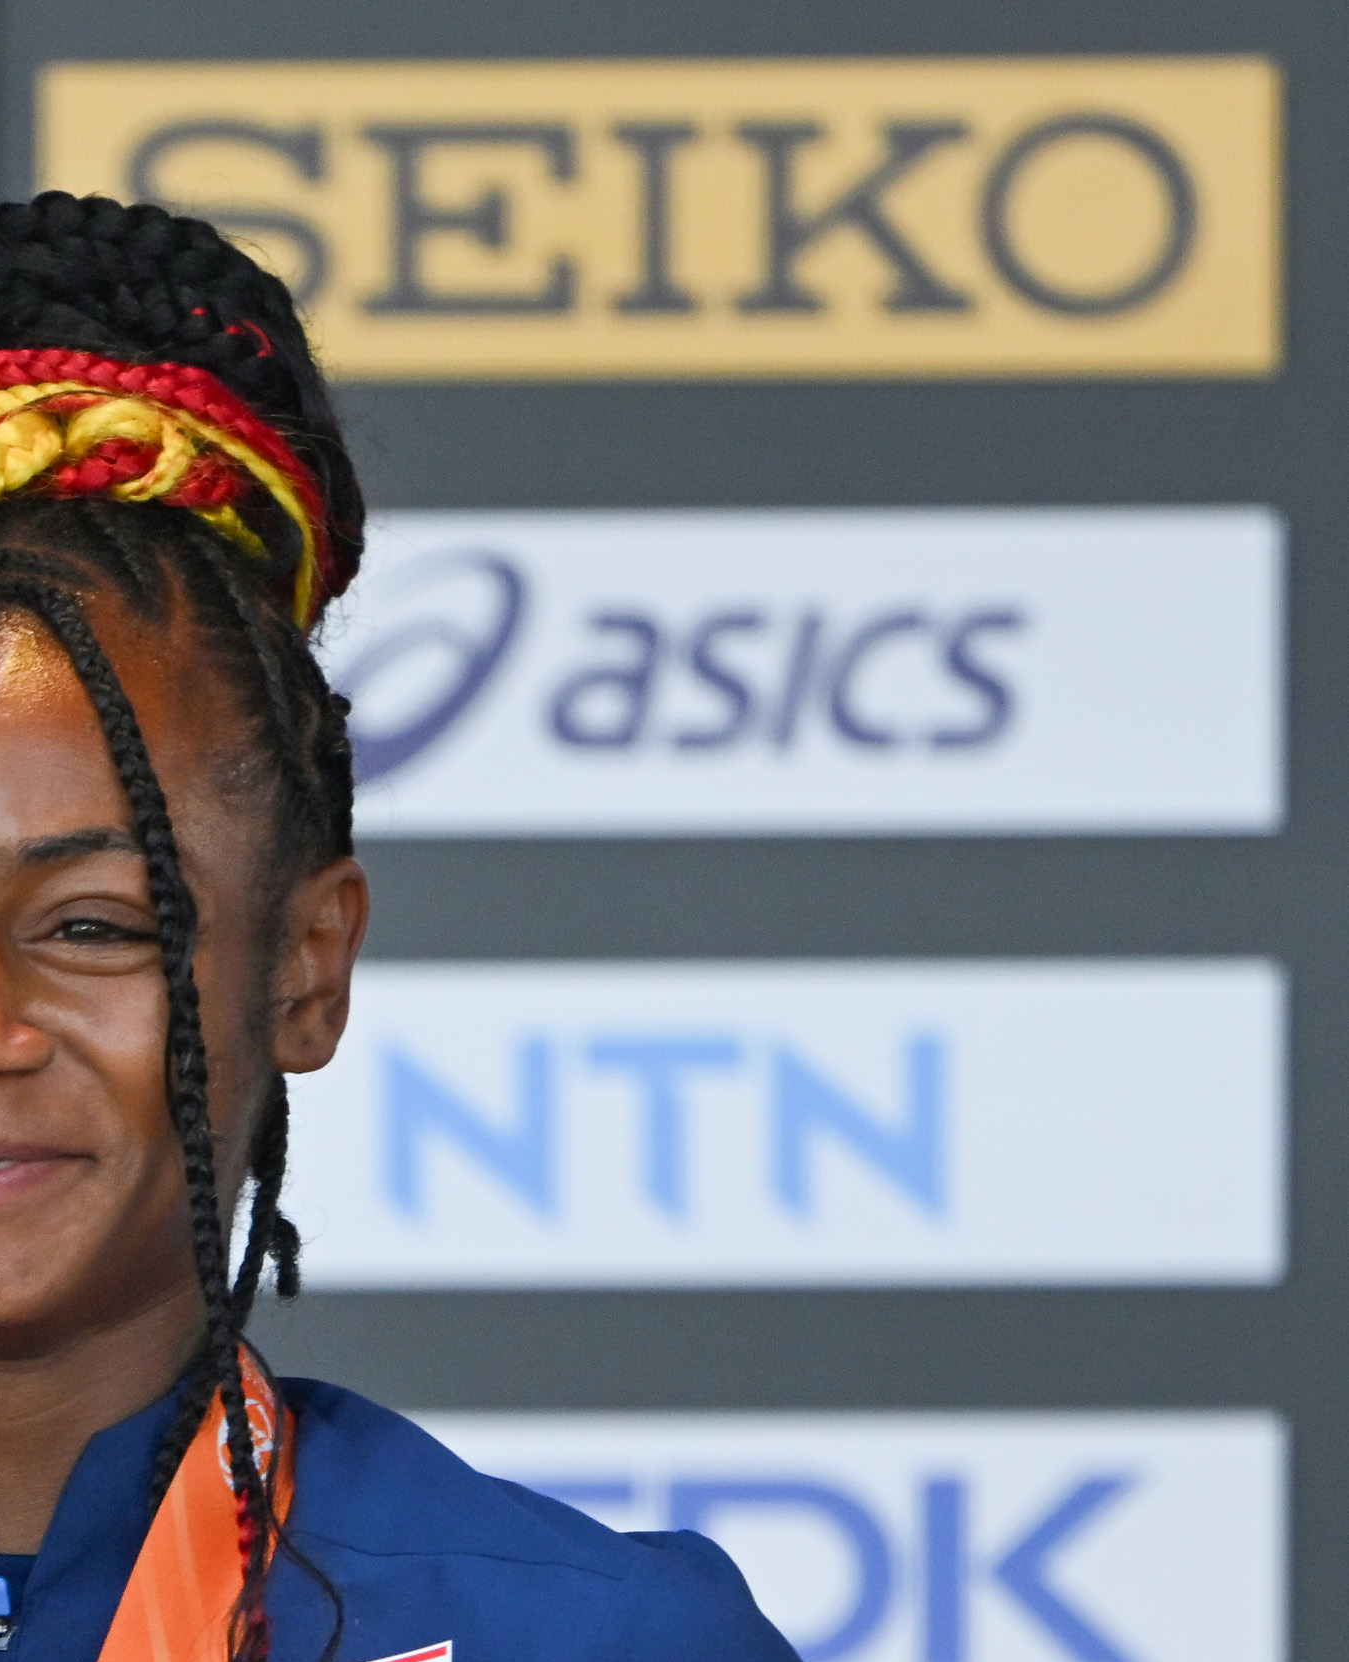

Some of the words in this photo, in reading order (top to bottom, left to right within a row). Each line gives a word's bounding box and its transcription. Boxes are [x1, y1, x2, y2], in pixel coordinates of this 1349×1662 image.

[126, 109, 1198, 319] SEIKO
[544, 598, 1032, 756] asics
[380, 1031, 950, 1220] NTN
